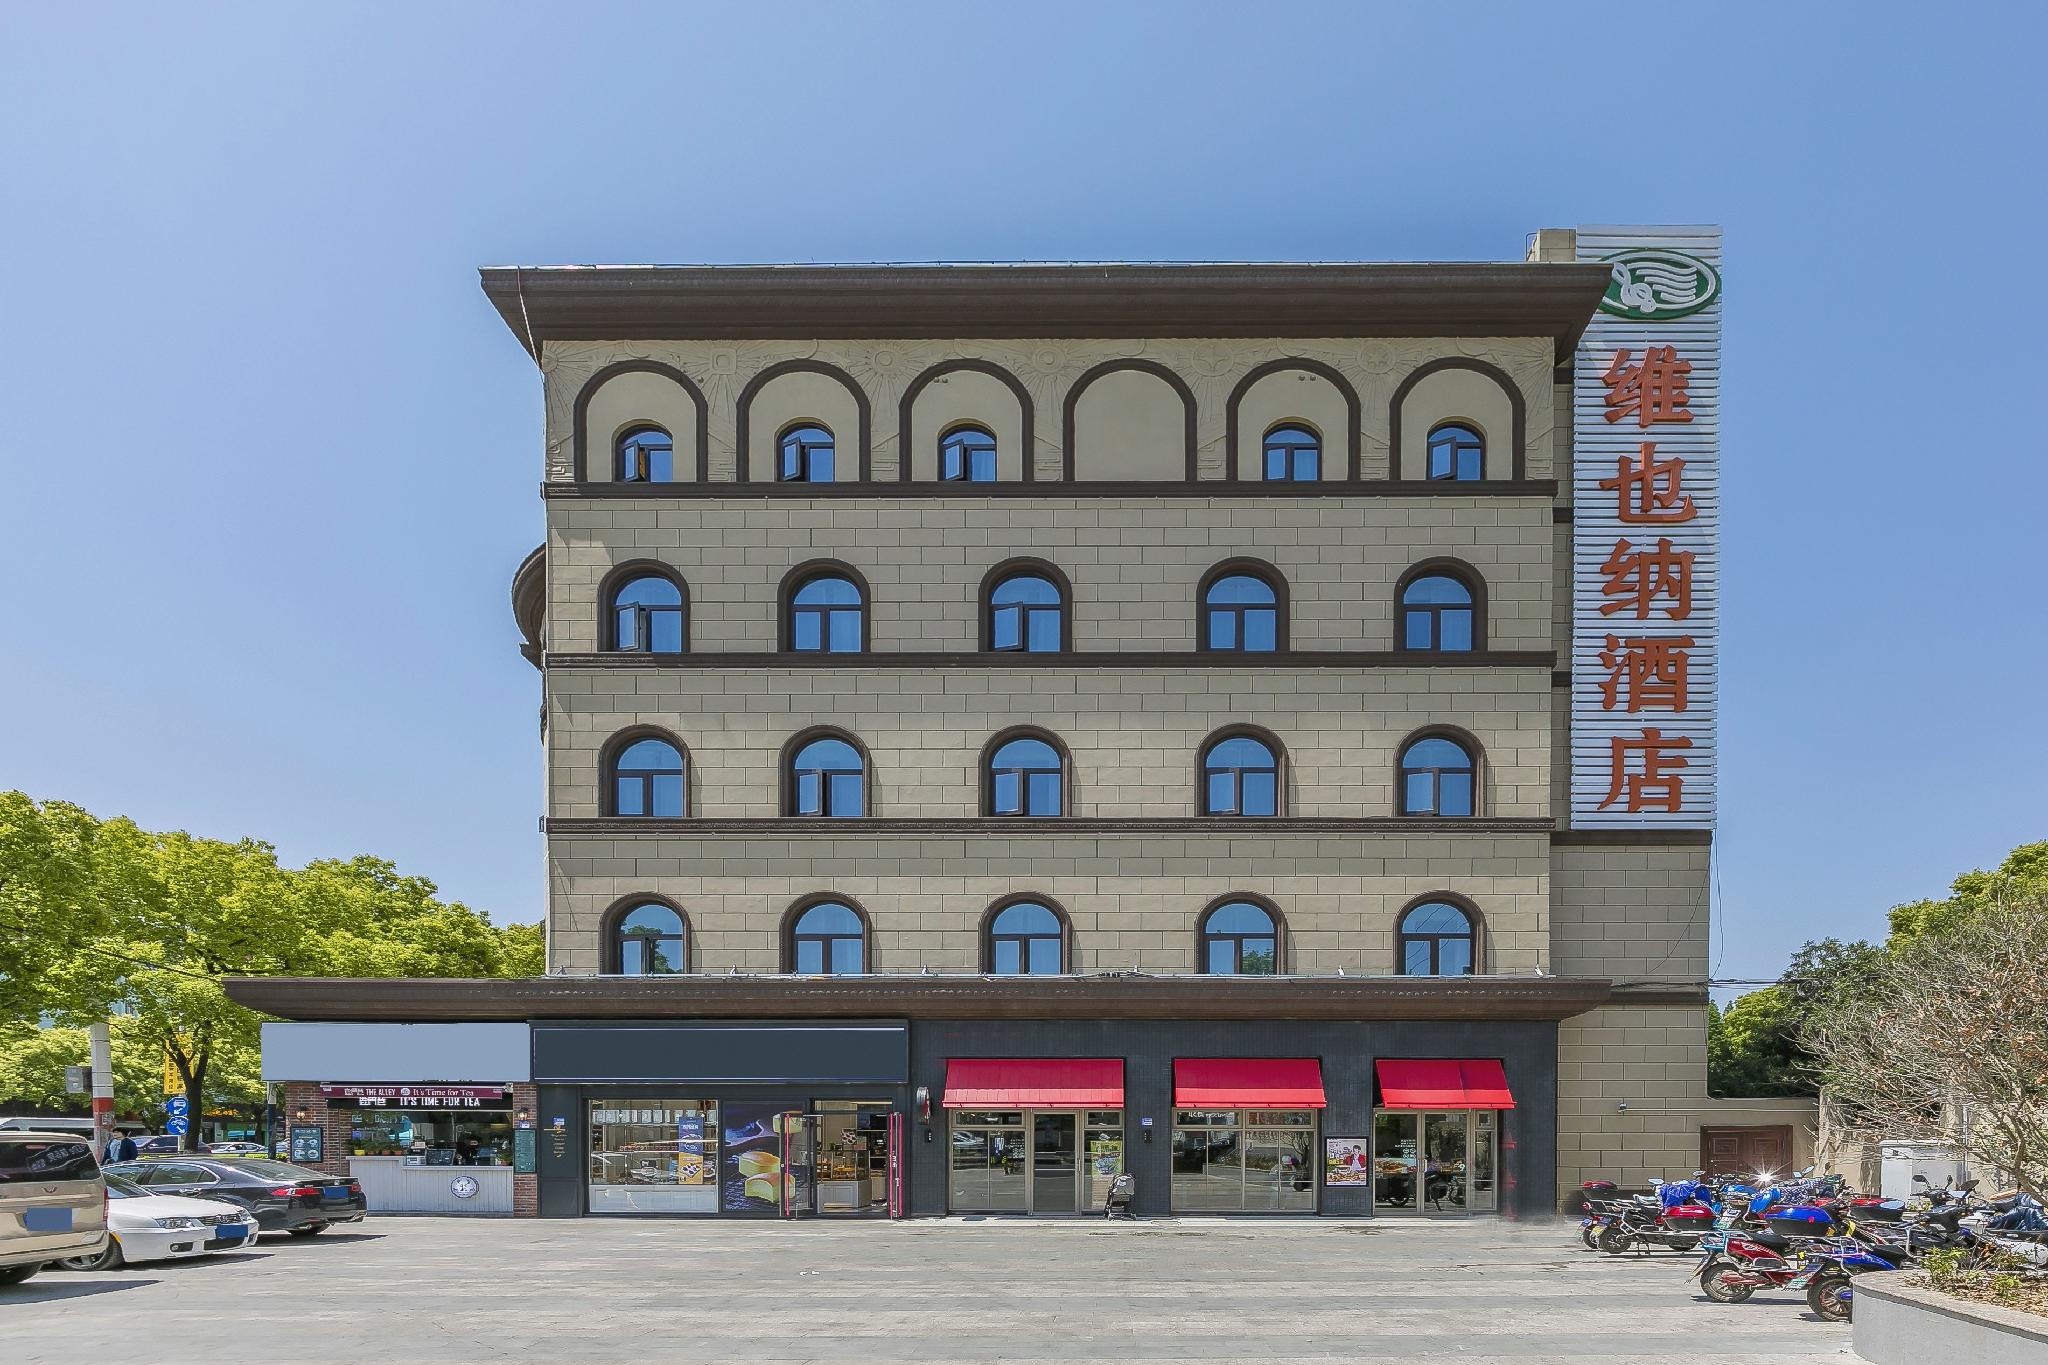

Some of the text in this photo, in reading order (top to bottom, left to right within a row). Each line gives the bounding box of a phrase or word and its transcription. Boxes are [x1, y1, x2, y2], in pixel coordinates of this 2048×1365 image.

[1598, 344, 1698, 813] 维也纳酒店
[366, 1088, 396, 1096] THE ALLEY
[413, 1088, 474, 1096] It's Time for Tea
[400, 1097, 481, 1106] IT'S TIME FOR TEA
